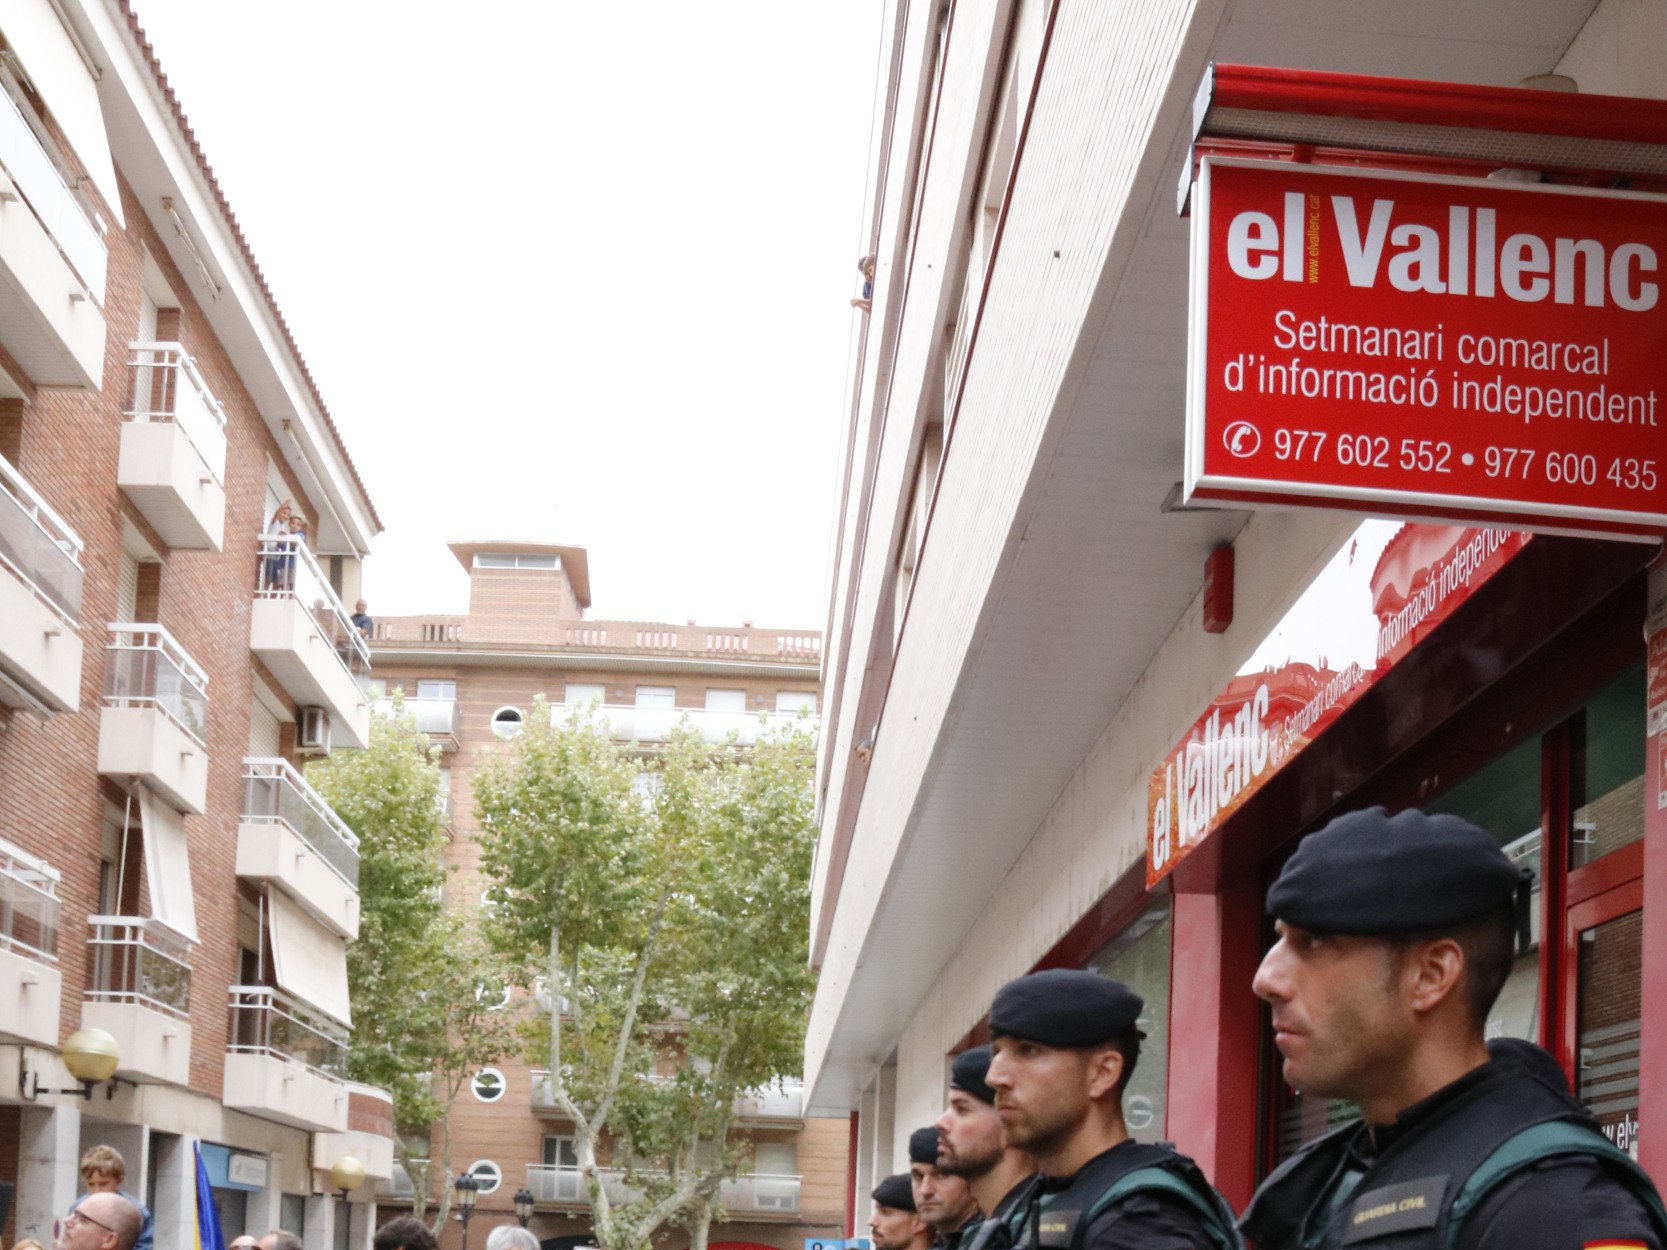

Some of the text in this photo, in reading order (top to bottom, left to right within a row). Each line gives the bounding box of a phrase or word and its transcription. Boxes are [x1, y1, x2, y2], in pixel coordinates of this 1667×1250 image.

[1227, 191, 1659, 312] el Vallenc
[1308, 194, 1320, 284] www.elvallenc.cat
[1273, 310, 1609, 375] Setmanari comarcal
[1224, 354, 1658, 427] d'informació independent
[1274, 429, 1657, 491] 977 602 552 977 600 435
[1153, 684, 1268, 871] el Vallenc
